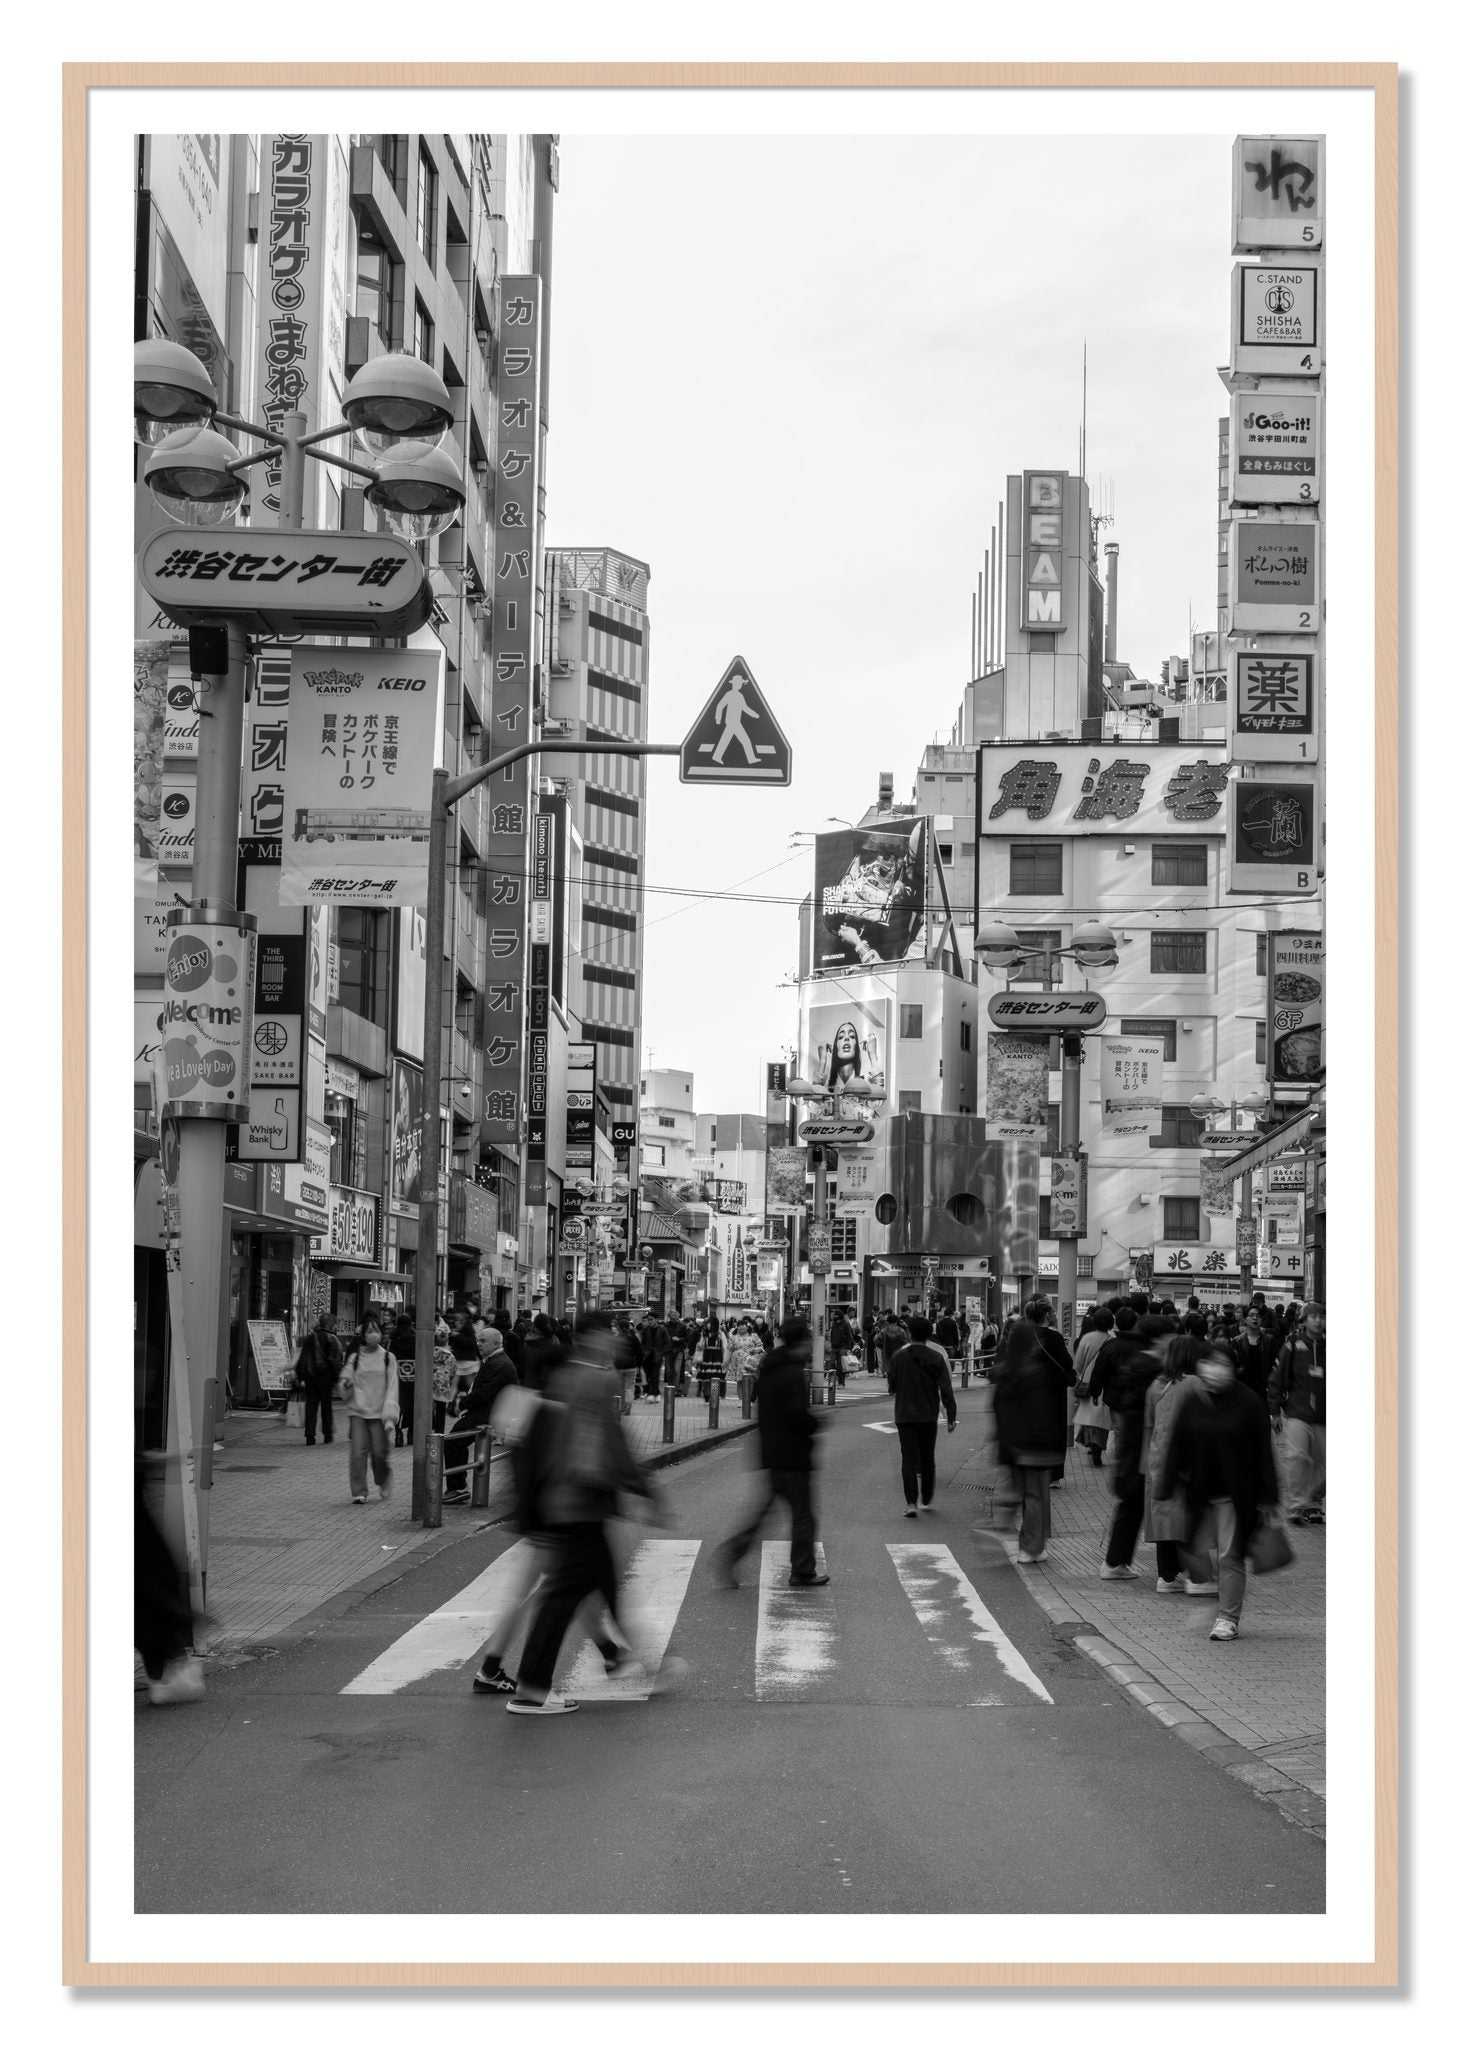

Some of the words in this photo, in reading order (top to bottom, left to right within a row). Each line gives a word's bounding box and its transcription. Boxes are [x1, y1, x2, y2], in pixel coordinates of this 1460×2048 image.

[270, 138, 312, 280] カラオケ
[1301, 226, 1315, 242] 5
[1256, 274, 1302, 284] C.STAND
[1256, 315, 1302, 326] SHISHA
[1300, 354, 1313, 370] 4
[1255, 414, 1311, 431] Goo-it!
[1248, 434, 1307, 444] 渋谷宇田川町店
[1243, 460, 1312, 472] 全身もみほぐし
[1299, 483, 1312, 499] 3
[1029, 475, 1061, 622] BEAM
[155, 548, 408, 587] 渋谷センター街
[1244, 554, 1309, 575] ポムの樹
[1254, 578, 1301, 586] Pomme-no-ki
[1299, 611, 1311, 628] 2
[316, 686, 352, 694] KANTO
[377, 677, 427, 692] KEIO
[1247, 661, 1299, 713] 薬
[1241, 716, 1304, 730] マツモトキヨシ
[321, 713, 337, 757] 冒険へ
[168, 742, 193, 751] 渋谷店
[339, 714, 358, 789] カントーの
[360, 714, 379, 789] ポケパーク
[382, 714, 399, 775] 京王線で
[1298, 742, 1307, 757] 1
[988, 759, 1232, 821] 角海老
[1242, 798, 1303, 847] 一蘭
[538, 818, 547, 855] kimono
[164, 851, 190, 860] 渋谷店
[308, 878, 398, 892] 渋谷センター街
[537, 860, 547, 894] hearts
[1297, 871, 1310, 888] B
[167, 948, 209, 985] Enjoy
[1276, 952, 1321, 965] 四川料理
[265, 994, 280, 1002] BAR
[164, 1000, 241, 1025] Welcome
[995, 1001, 1099, 1015] 渋谷センター街
[1274, 1011, 1303, 1031] 6F
[181, 1058, 212, 1078] Lovely
[214, 1060, 234, 1074] Day!
[250, 1125, 283, 1136] Whisky
[614, 1128, 635, 1140] GU
[802, 1125, 865, 1135] 渋谷センター街
[249, 1134, 270, 1143] Bank
[1168, 1249, 1228, 1271] 兆楽
[735, 1248, 743, 1291] BEER
[731, 1292, 744, 1300] HALL
